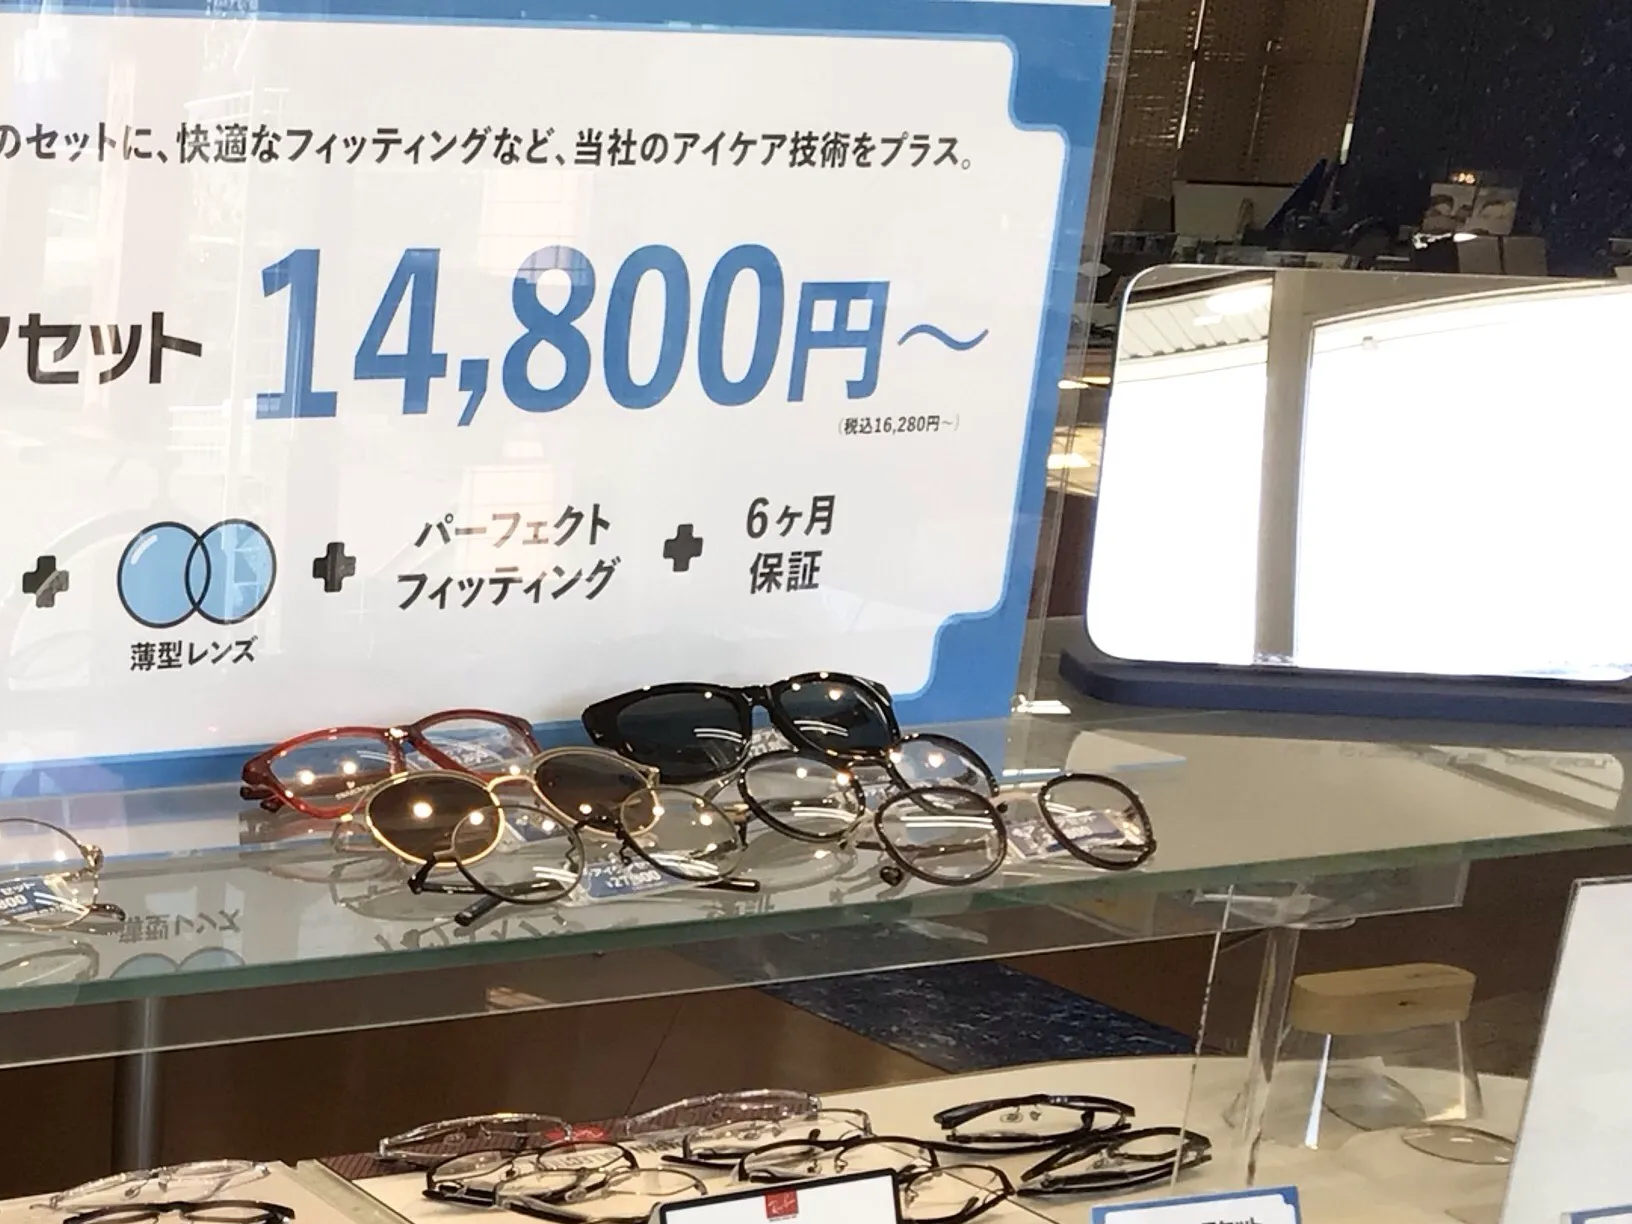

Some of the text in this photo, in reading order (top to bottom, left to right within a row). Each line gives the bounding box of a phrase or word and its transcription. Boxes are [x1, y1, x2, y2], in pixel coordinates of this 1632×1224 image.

[413, 503, 612, 549] パーフェクト
[397, 555, 622, 613] フィッティング
[748, 549, 823, 596] 保証
[130, 635, 257, 673] 薄型レンズ
